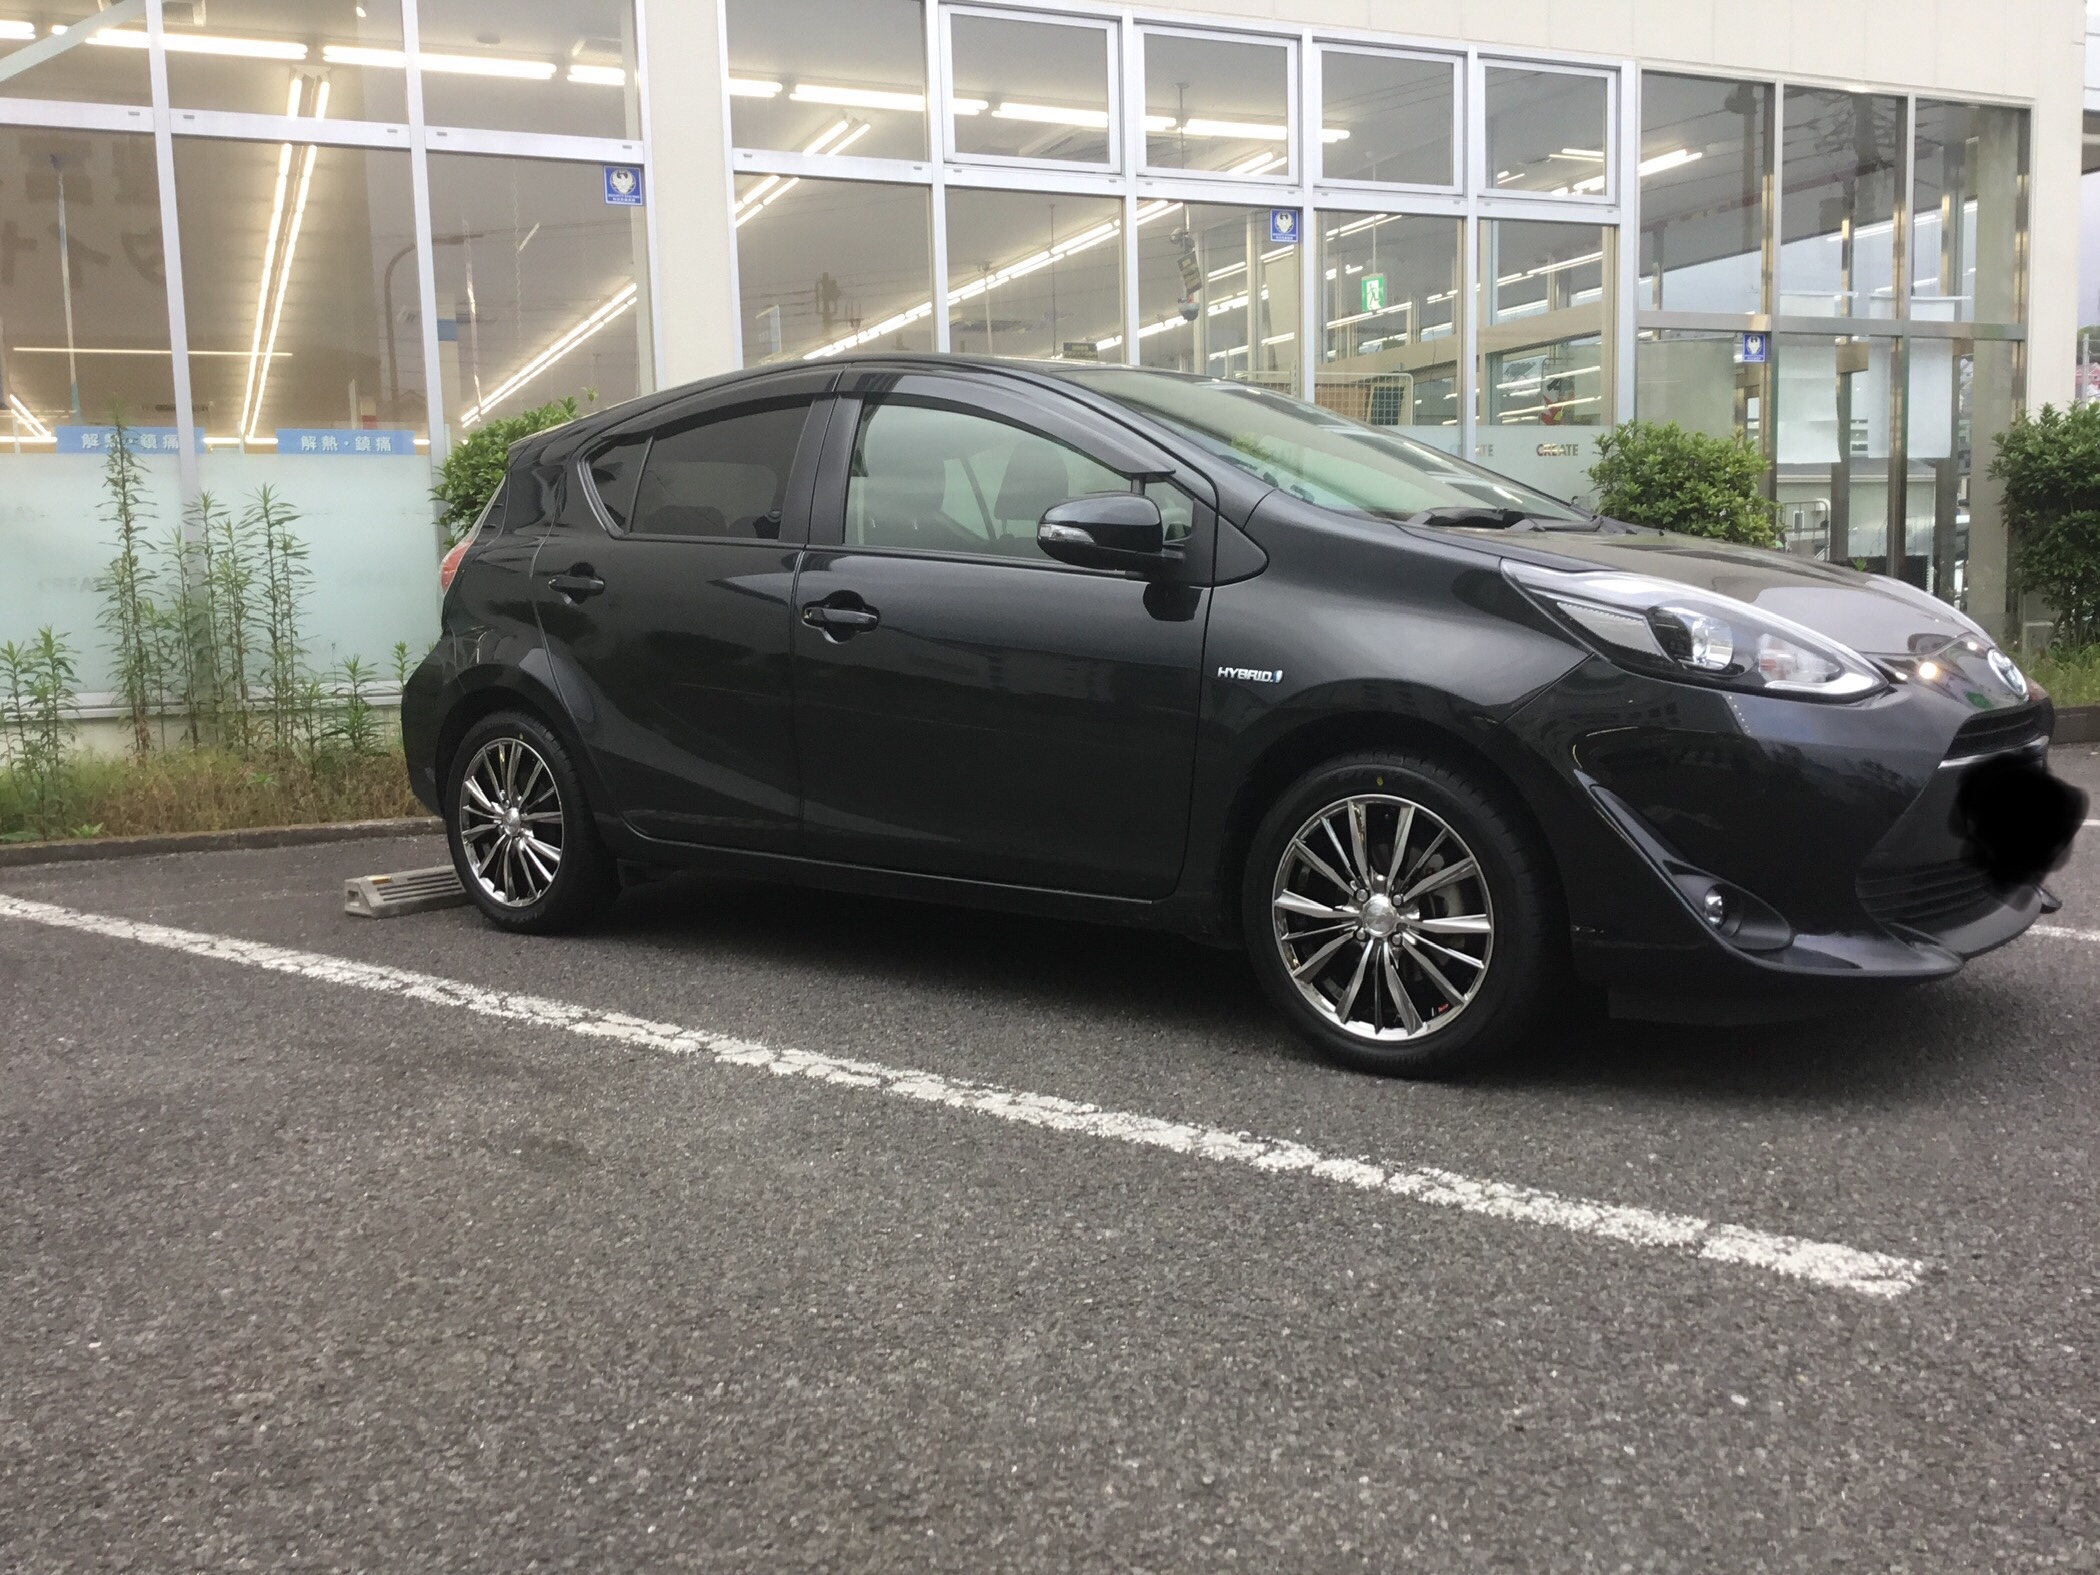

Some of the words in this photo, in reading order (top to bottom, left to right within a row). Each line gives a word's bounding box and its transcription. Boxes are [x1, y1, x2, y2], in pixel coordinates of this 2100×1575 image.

[300, 435, 392, 452] 解熱・鎮痛
[1536, 443, 1579, 457] CREATE
